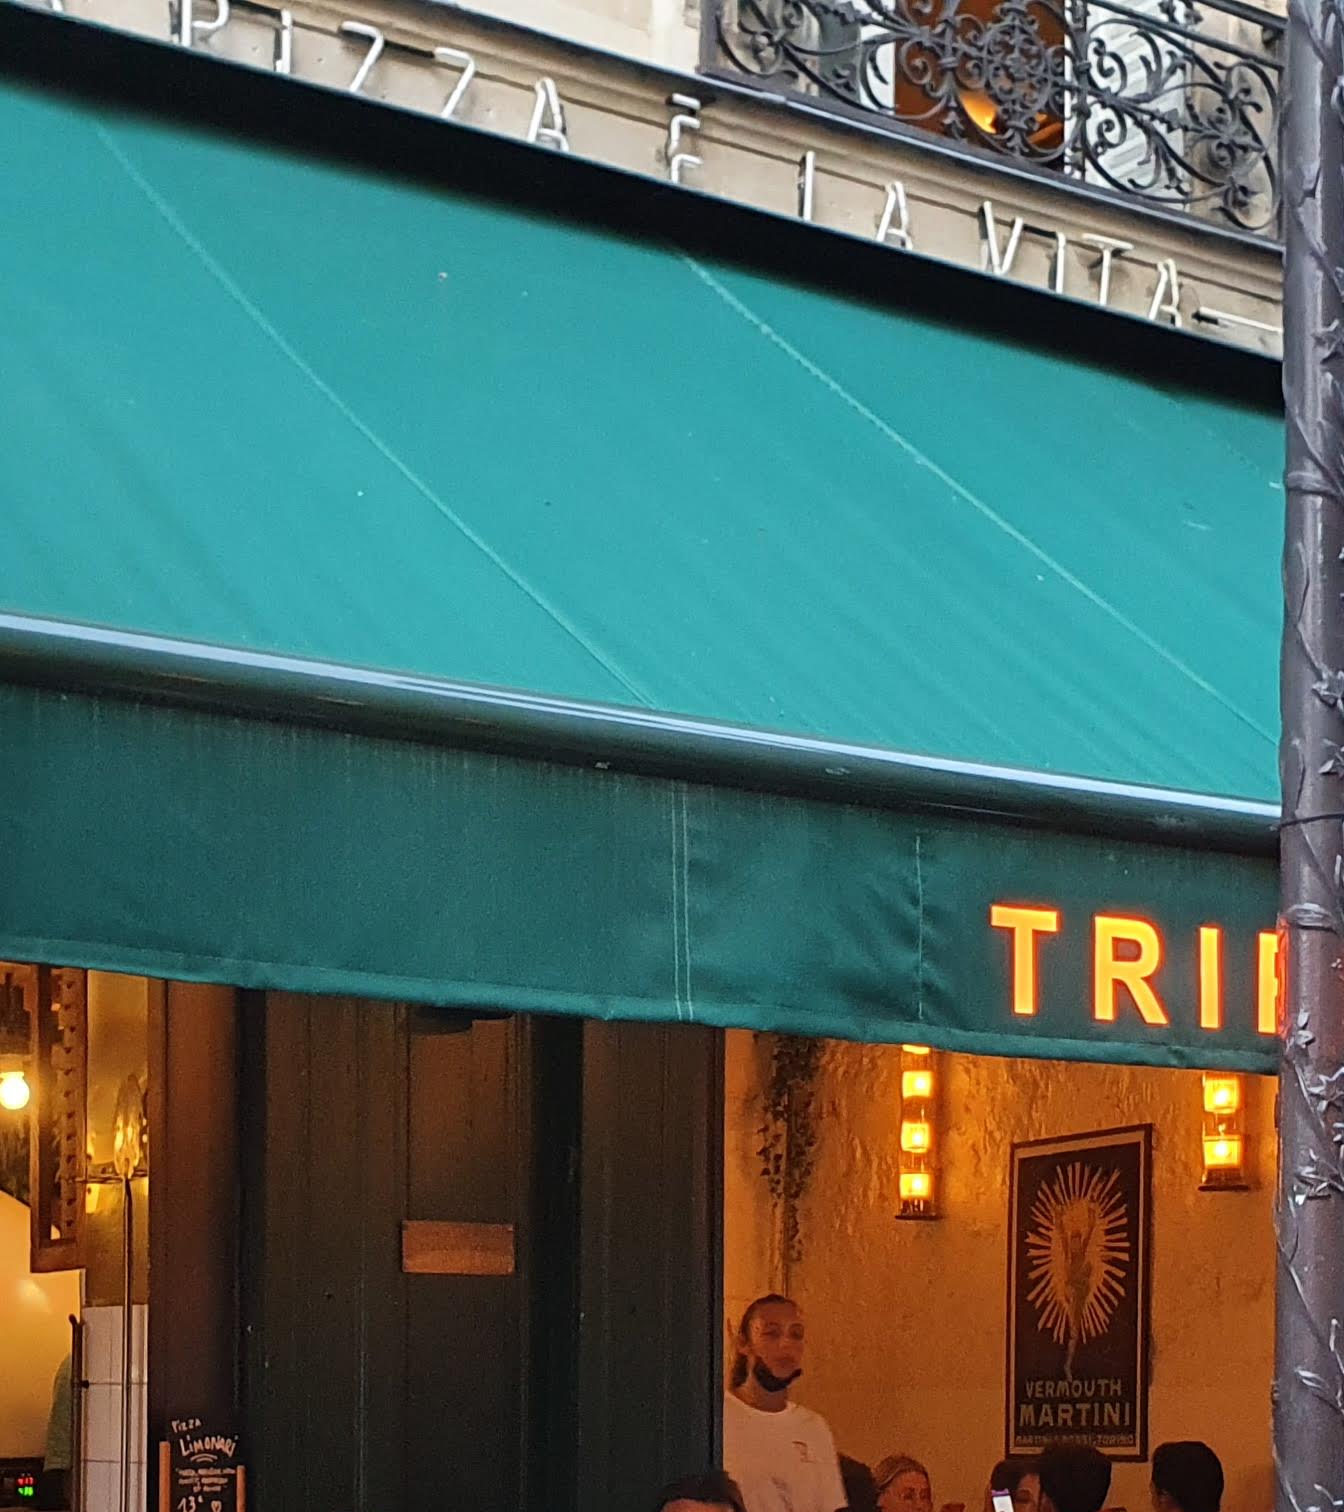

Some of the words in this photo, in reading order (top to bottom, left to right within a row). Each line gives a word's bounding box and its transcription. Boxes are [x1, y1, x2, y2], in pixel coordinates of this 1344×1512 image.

[983, 200, 1185, 327] VITA
[1025, 1379, 1123, 1399] VERMOUTH
[1018, 1401, 1131, 1427] MARTINI
